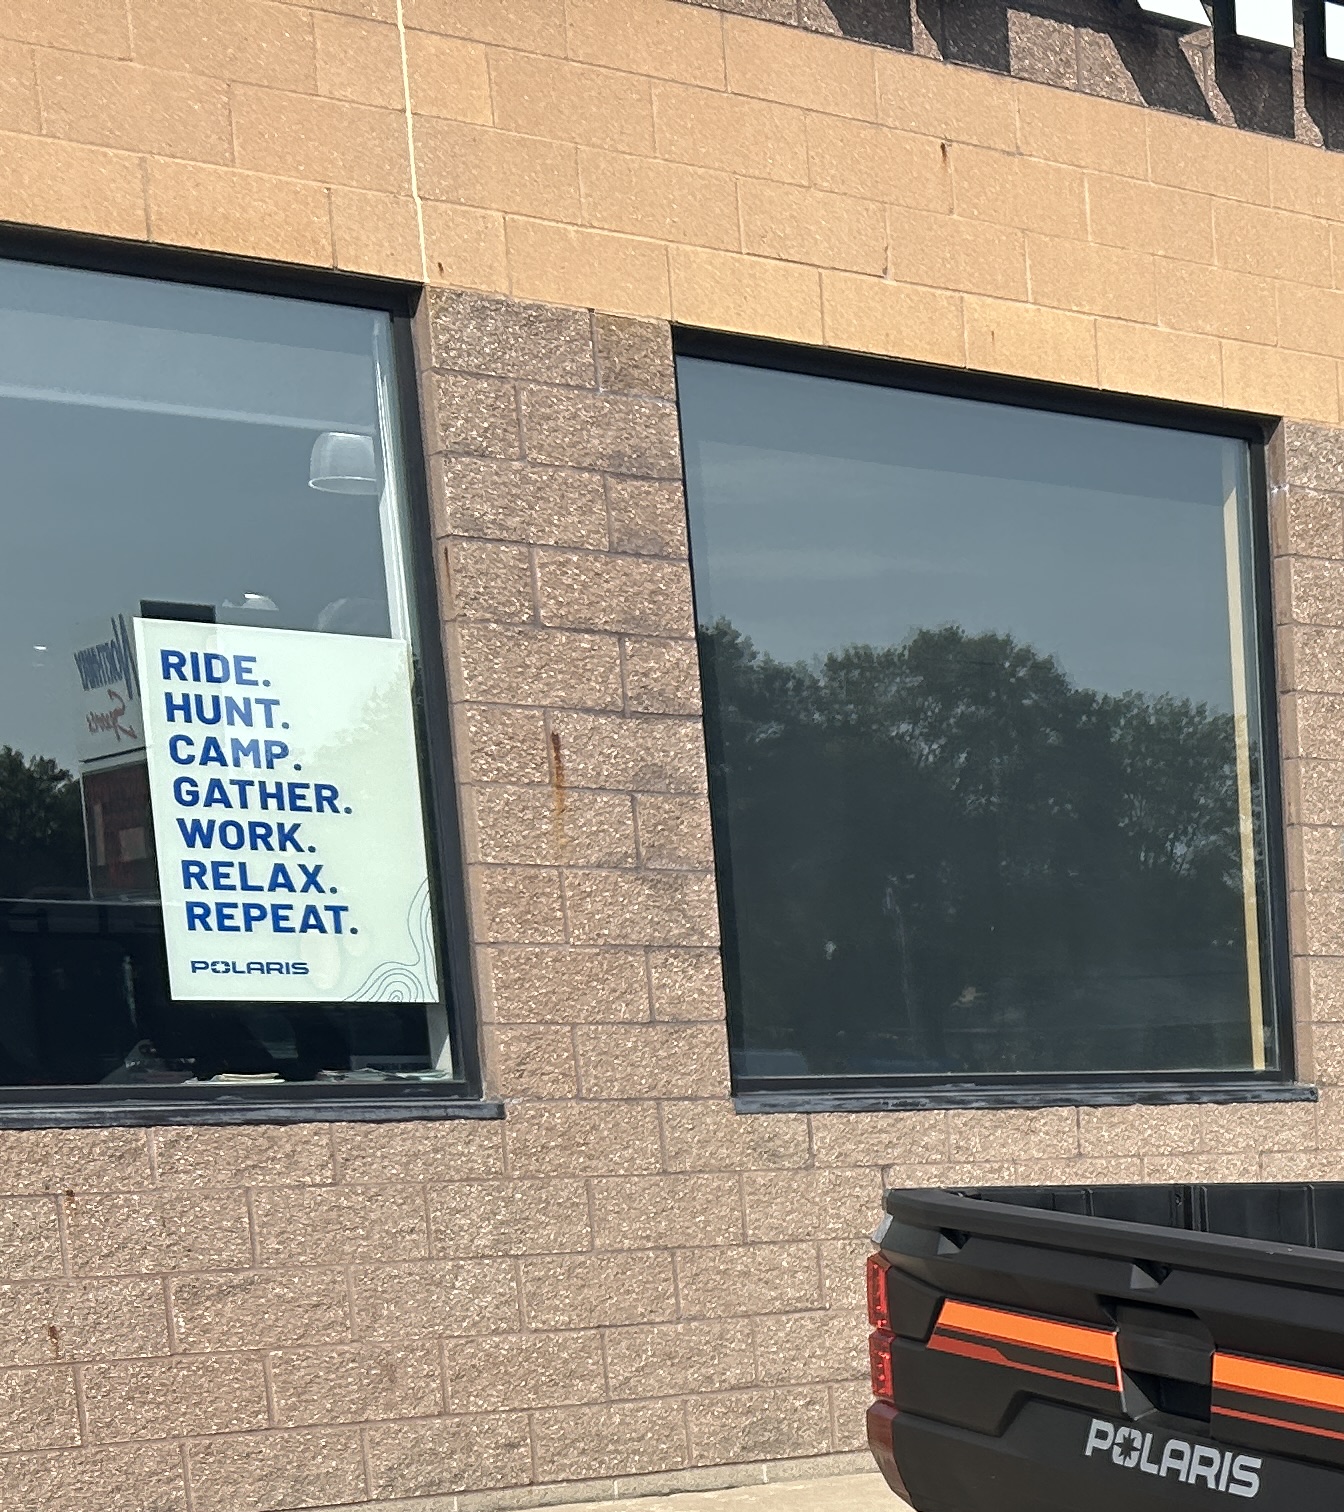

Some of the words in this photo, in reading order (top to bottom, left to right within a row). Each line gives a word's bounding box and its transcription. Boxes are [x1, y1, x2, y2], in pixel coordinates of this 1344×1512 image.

[160, 649, 271, 687] RIDE.
[165, 692, 290, 729] HUNT.
[169, 734, 302, 771] CAMP.
[173, 776, 352, 815] GATHER.
[177, 818, 316, 853] WORK.
[182, 860, 338, 894] RELAX.
[186, 901, 359, 935] REPEAT.
[191, 960, 309, 975] POLARIS
[1083, 1418, 1262, 1499] POLARIS
